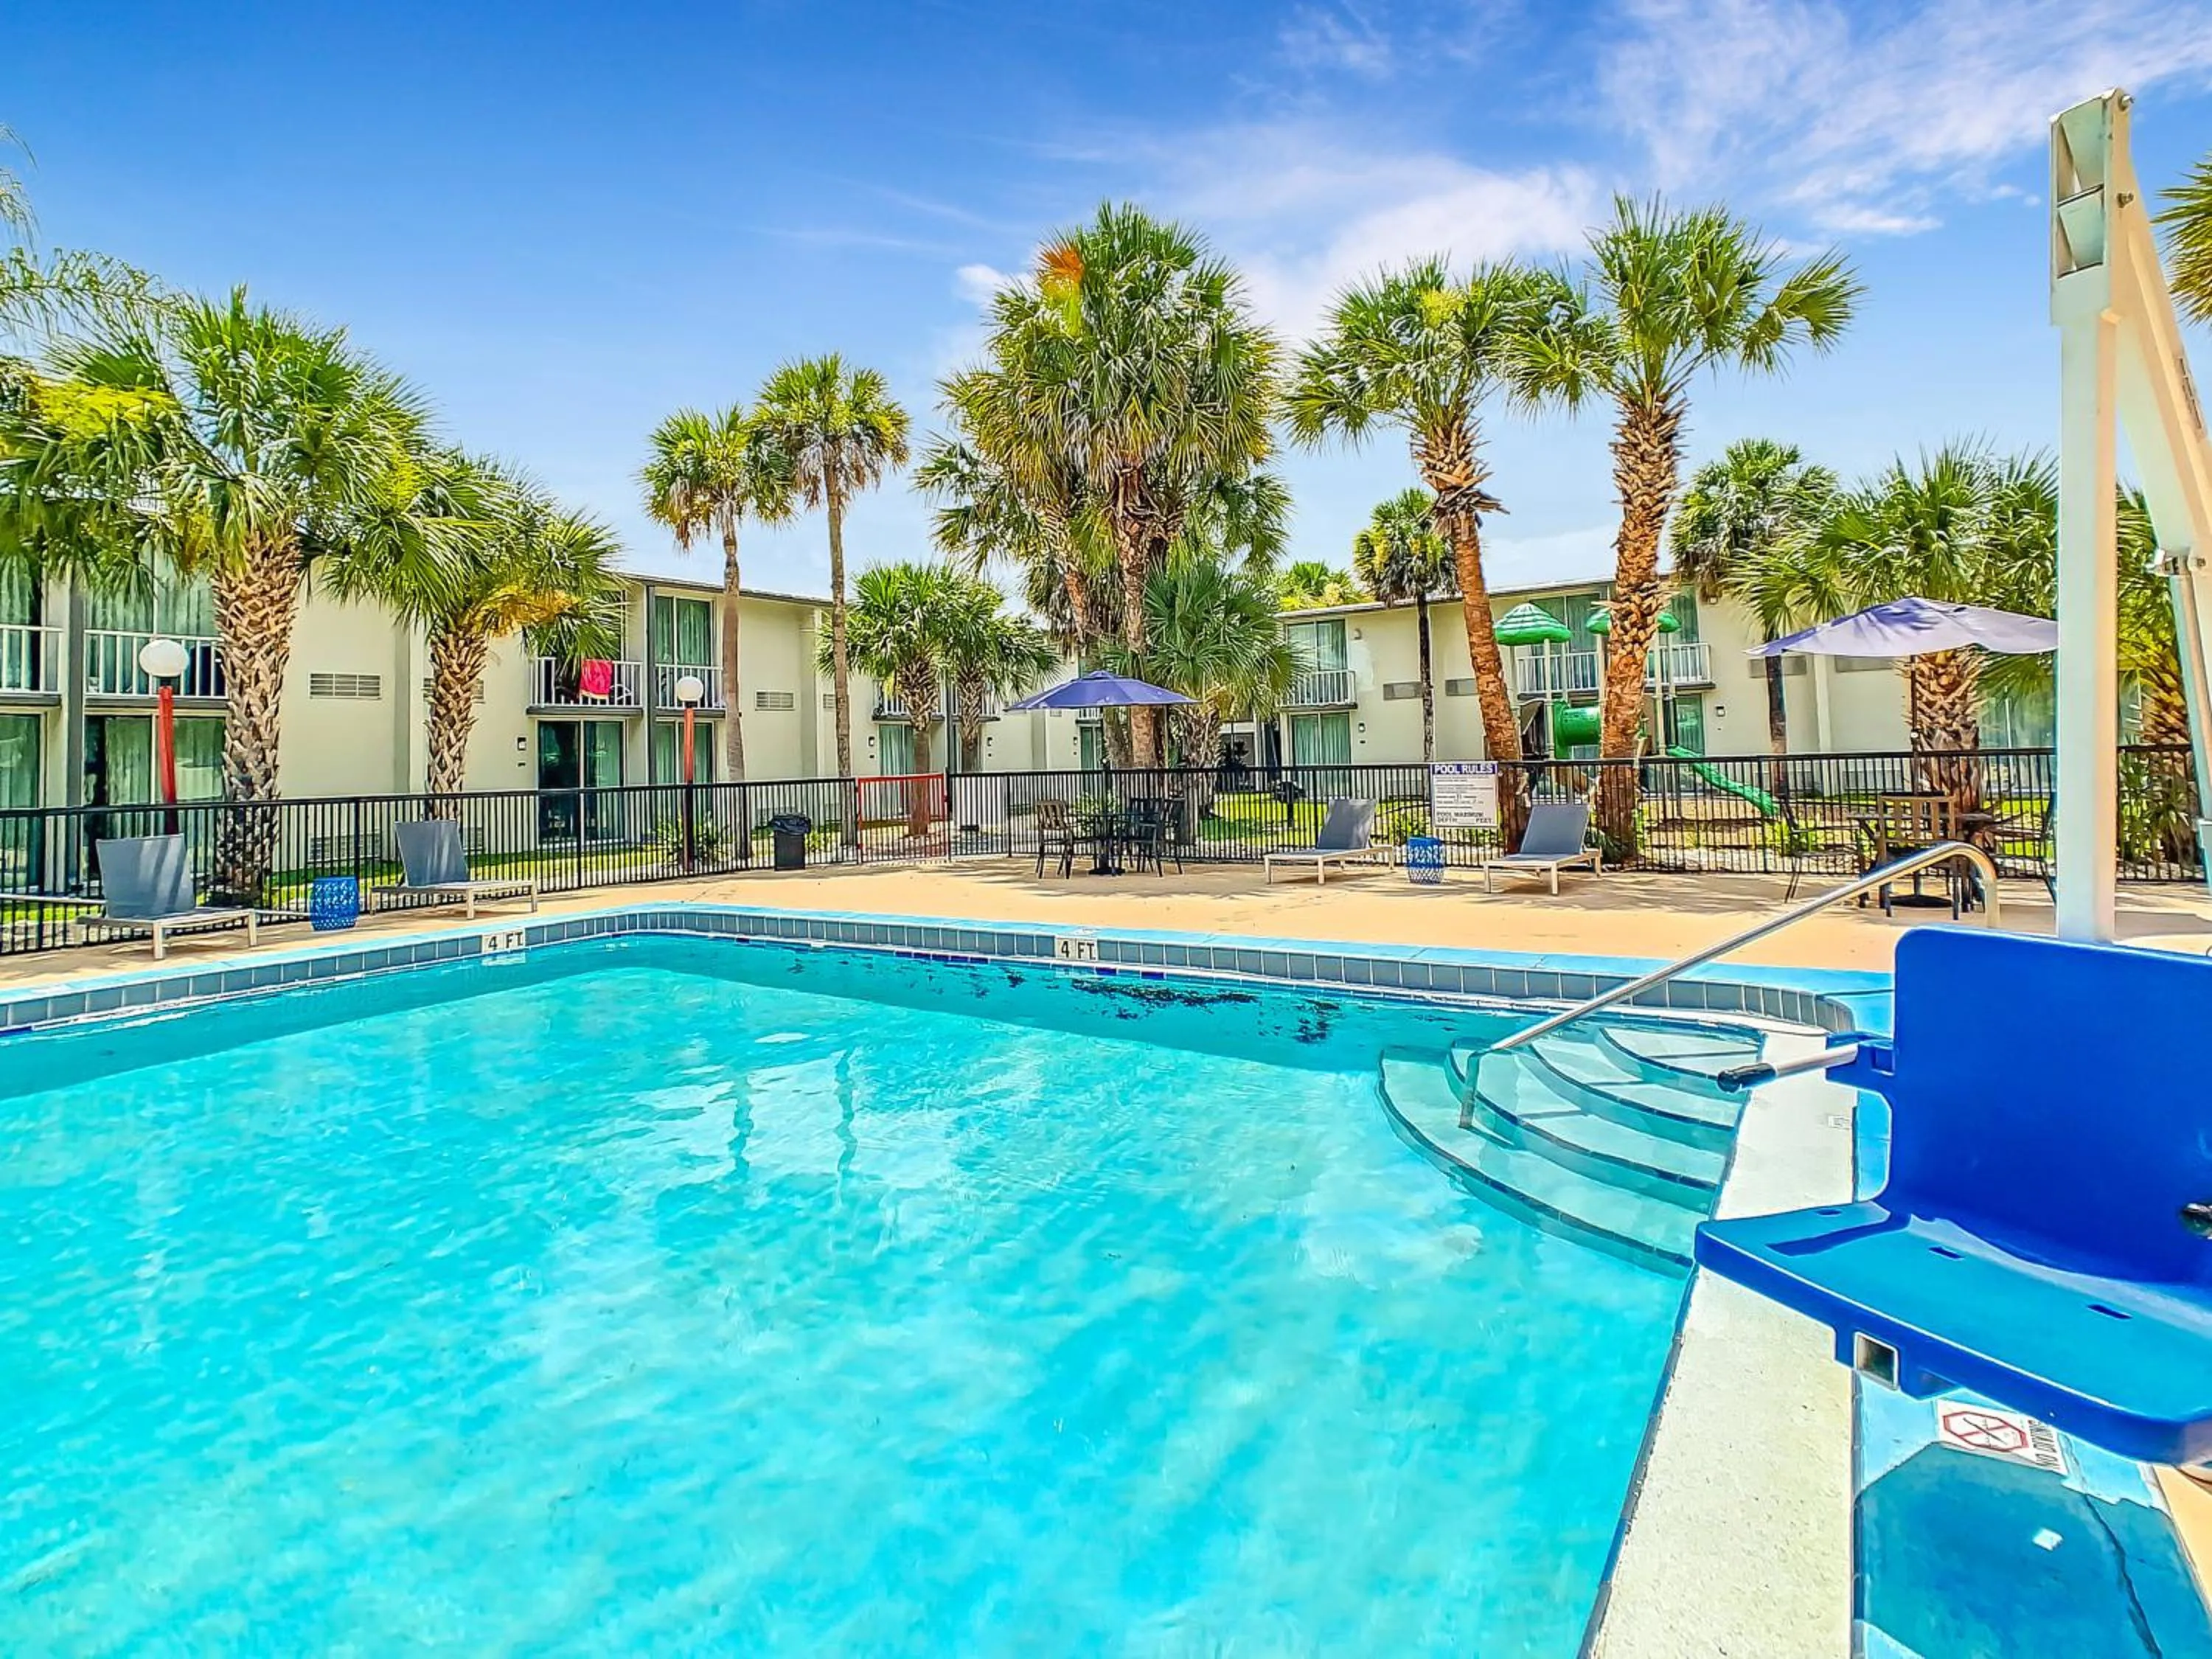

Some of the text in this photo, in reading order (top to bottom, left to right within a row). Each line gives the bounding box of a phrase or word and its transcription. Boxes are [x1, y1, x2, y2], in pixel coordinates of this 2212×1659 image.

[1434, 764, 1493, 773] POOL RULES
[488, 935, 497, 950] 4
[1061, 940, 1070, 958] 4
[2034, 1453, 2061, 1470] NO
